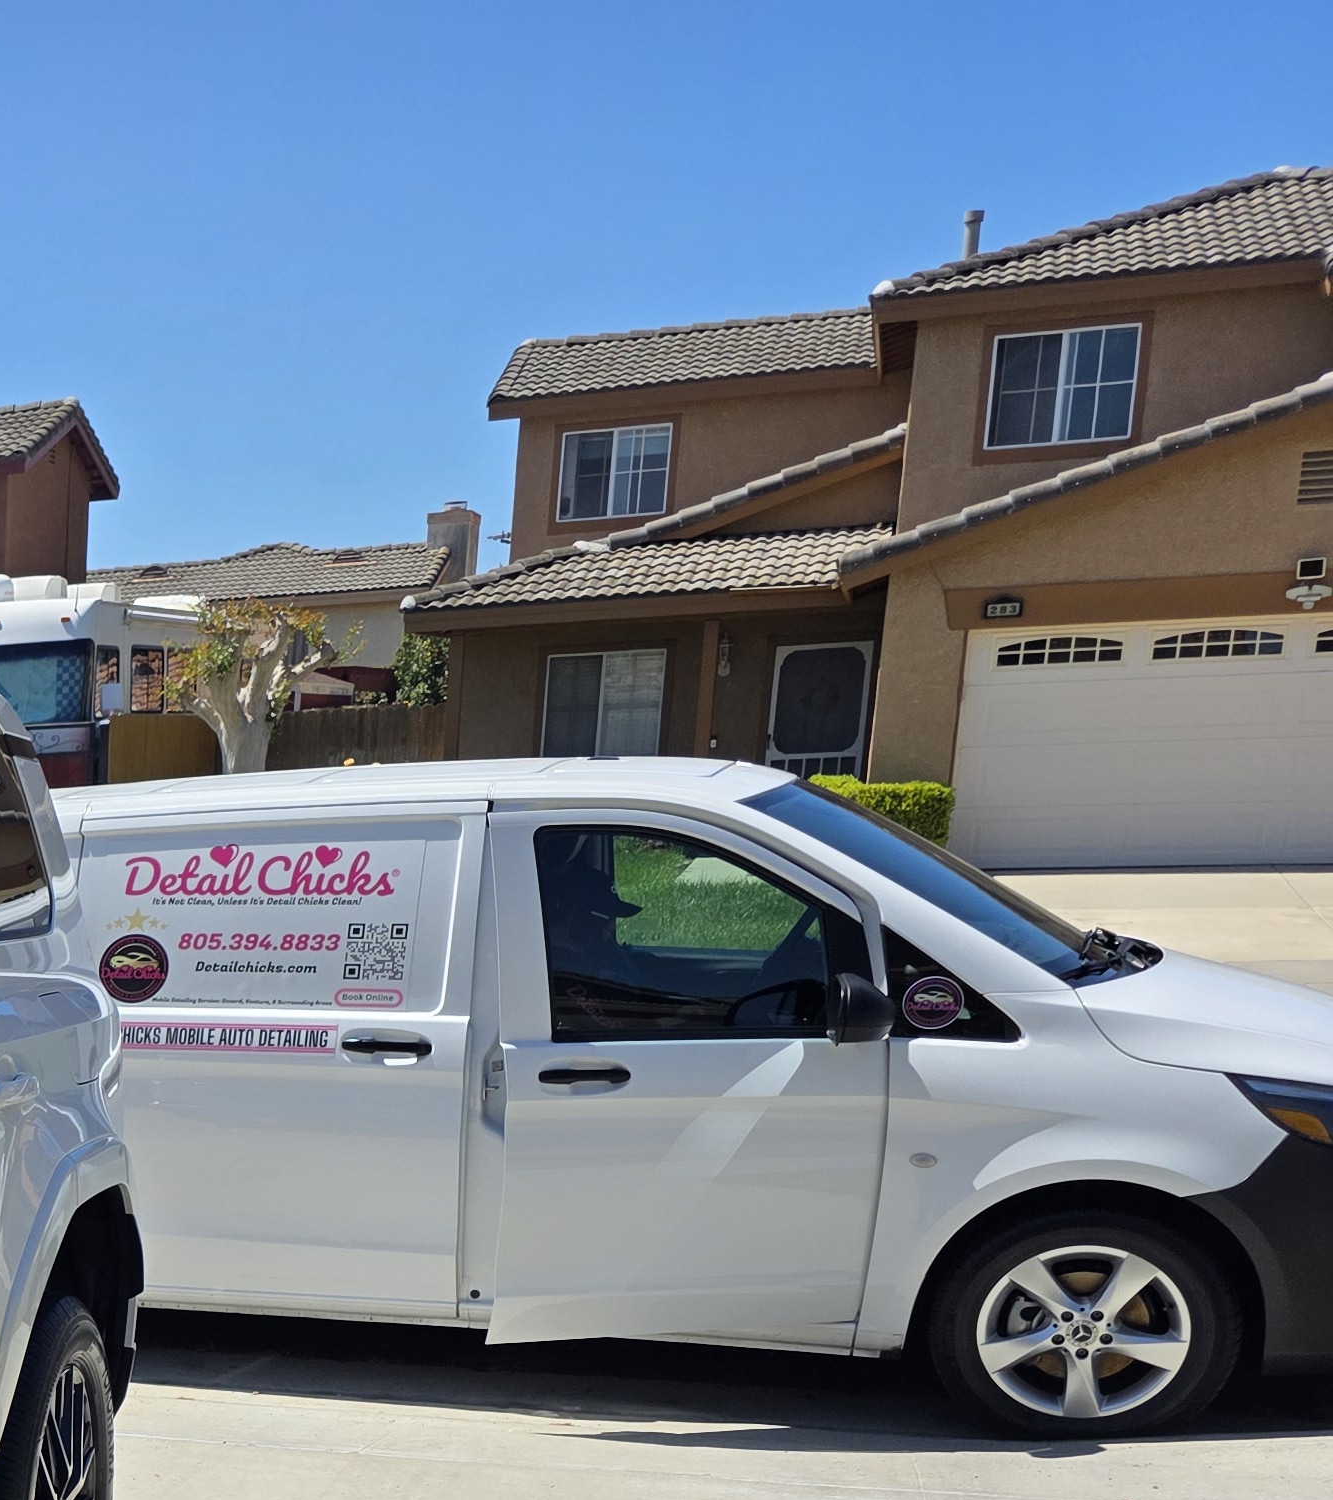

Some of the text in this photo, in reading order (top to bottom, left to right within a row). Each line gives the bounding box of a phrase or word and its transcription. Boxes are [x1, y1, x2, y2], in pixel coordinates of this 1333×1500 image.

[125, 845, 254, 896] Detail
[152, 897, 362, 906] It's Not Clean, Unless It's Detail Chicks Clean!
[178, 933, 341, 952] 805.394.8833
[101, 965, 165, 979] Detail Chicks
[195, 961, 317, 974] Detailchicks.com
[342, 993, 394, 1002] Book Online
[165, 1028, 216, 1046] MOBILE
[218, 1028, 254, 1046] AUTO
[258, 1029, 329, 1048] DETAILING
